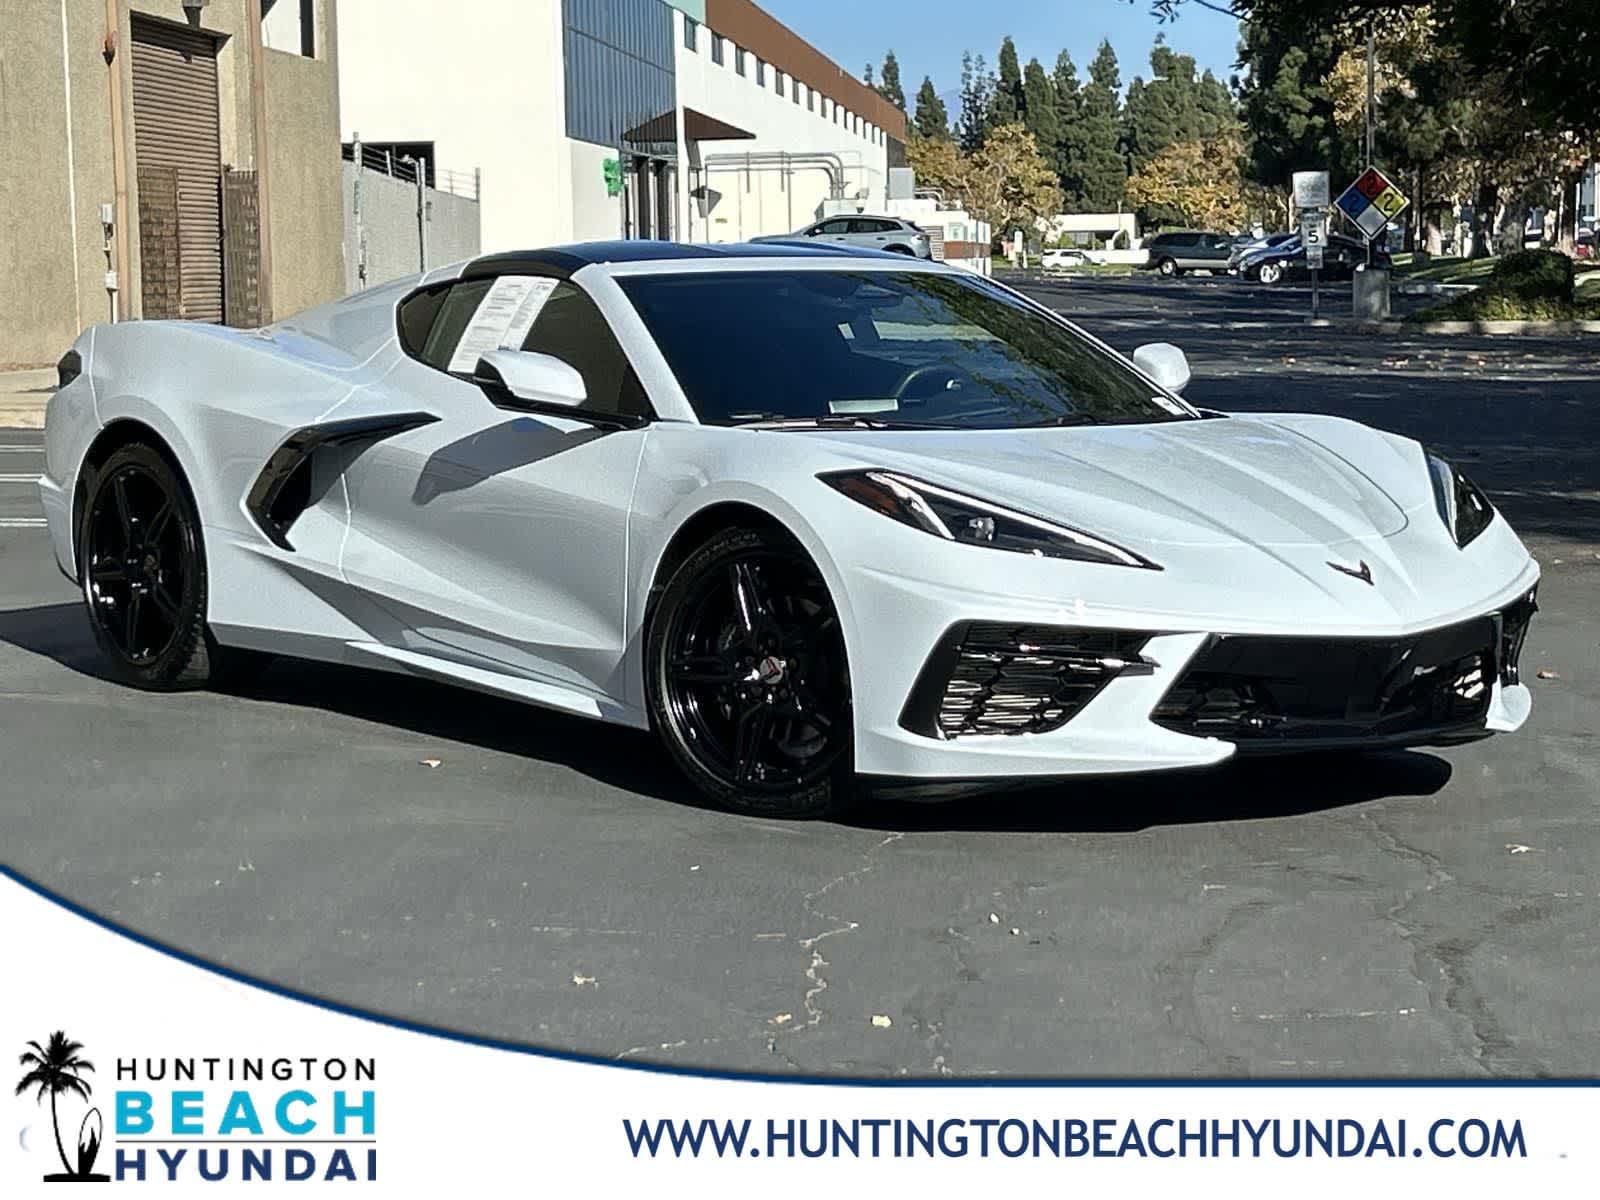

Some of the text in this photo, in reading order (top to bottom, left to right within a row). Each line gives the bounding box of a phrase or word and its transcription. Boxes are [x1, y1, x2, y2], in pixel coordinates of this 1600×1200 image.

[1348, 193, 1361, 212] 2
[1383, 193, 1394, 212] 2
[1308, 230, 1319, 244] 5
